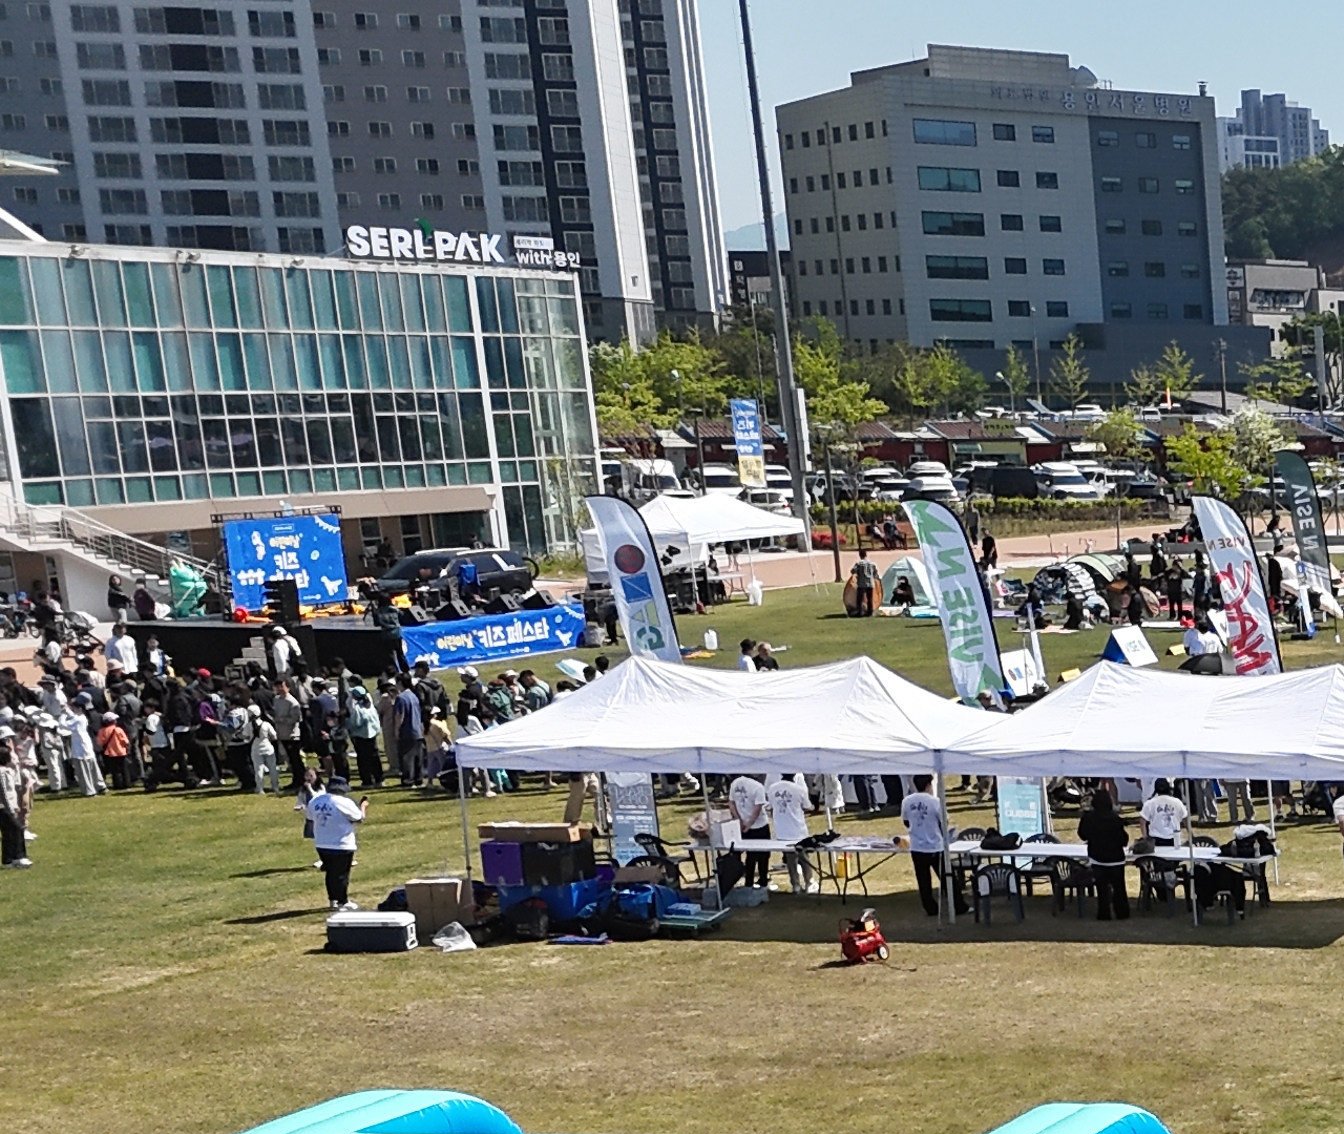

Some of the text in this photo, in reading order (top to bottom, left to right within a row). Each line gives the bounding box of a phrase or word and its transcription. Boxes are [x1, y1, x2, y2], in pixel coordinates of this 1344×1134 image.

[347, 225, 505, 263] SERI PAK
[515, 249, 582, 268] with 용인
